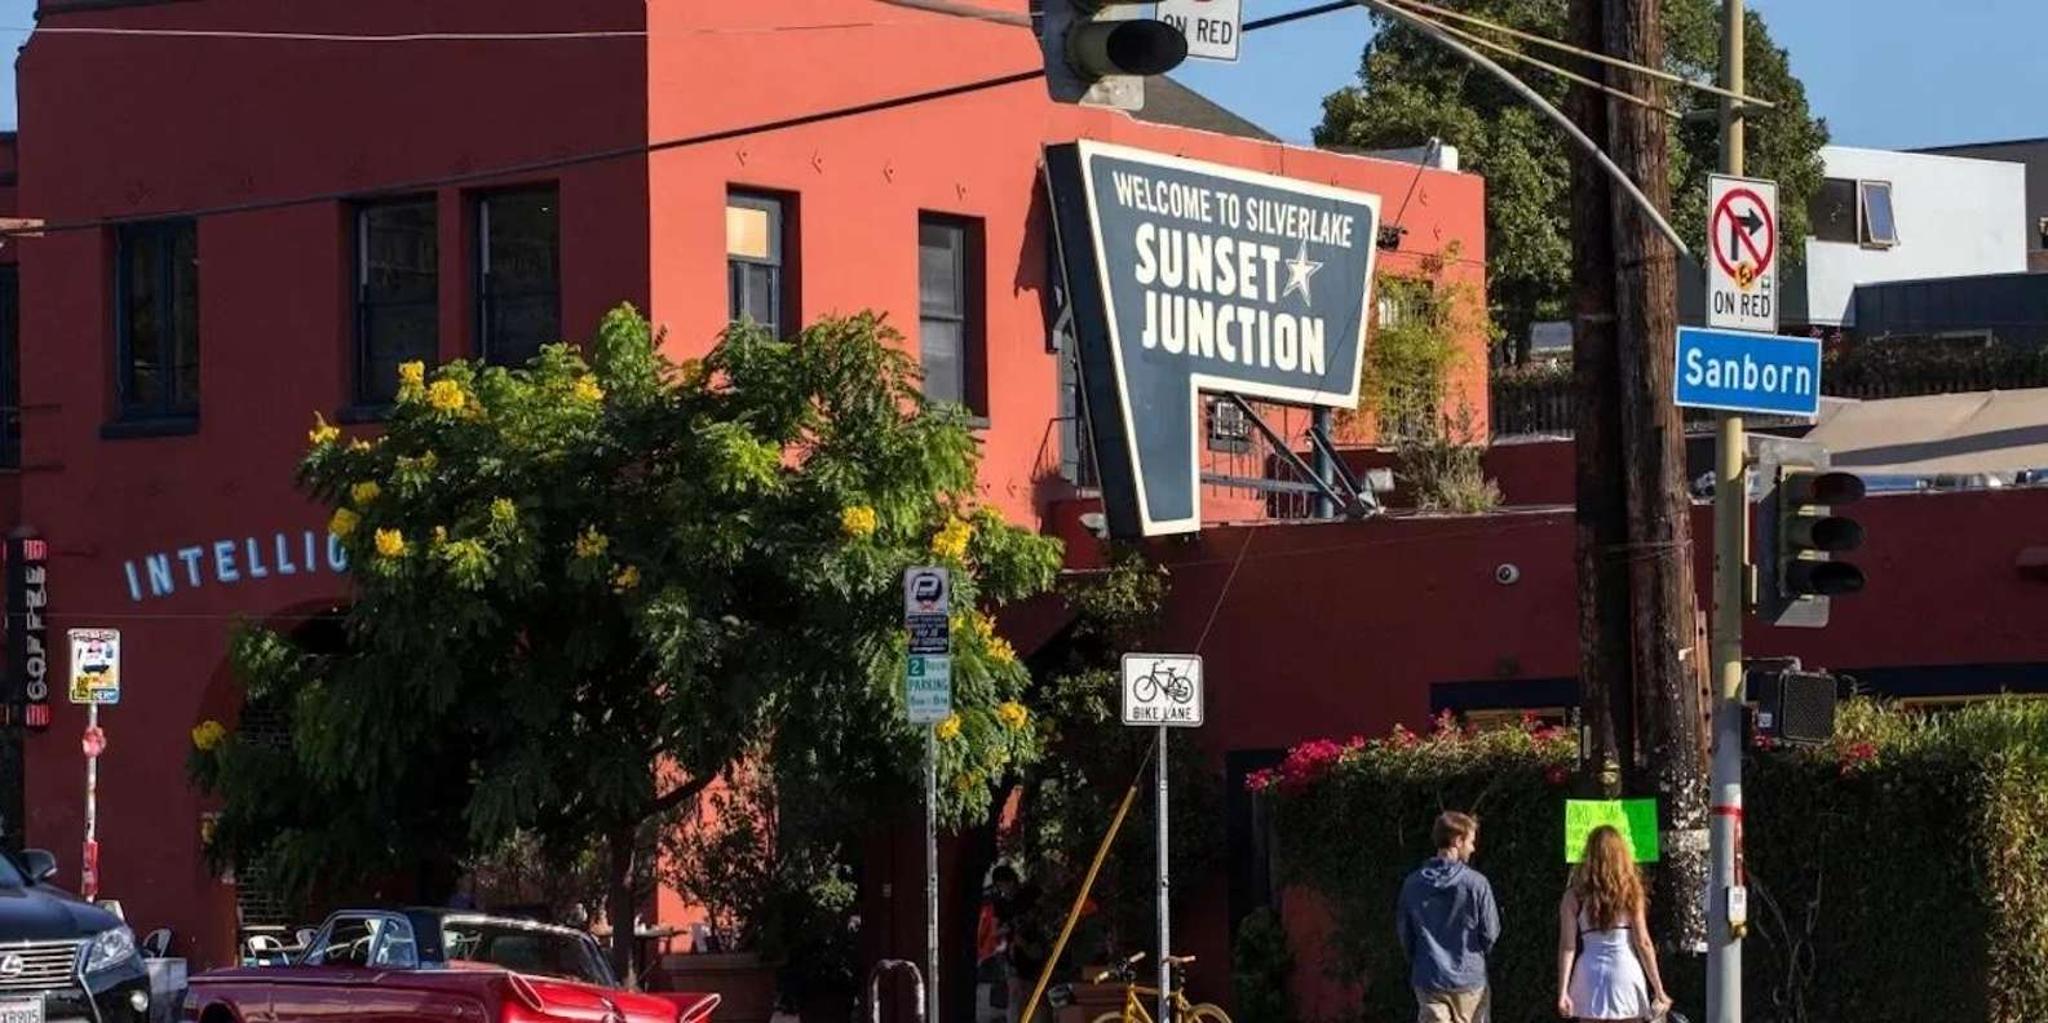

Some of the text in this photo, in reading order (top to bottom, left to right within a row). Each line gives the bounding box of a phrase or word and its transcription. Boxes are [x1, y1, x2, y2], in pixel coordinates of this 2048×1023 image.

[1197, 19, 1233, 44] RED
[1112, 171, 1353, 248] WELCOME TO SILVERLAKE
[1135, 223, 1280, 303] SUNSET
[1714, 290, 1771, 318] ON RED
[1142, 291, 1325, 376] JUNCTION
[1685, 347, 1811, 396] Sanborn
[911, 660, 921, 674] 2
[1132, 706, 1192, 720] BIKE LANE
